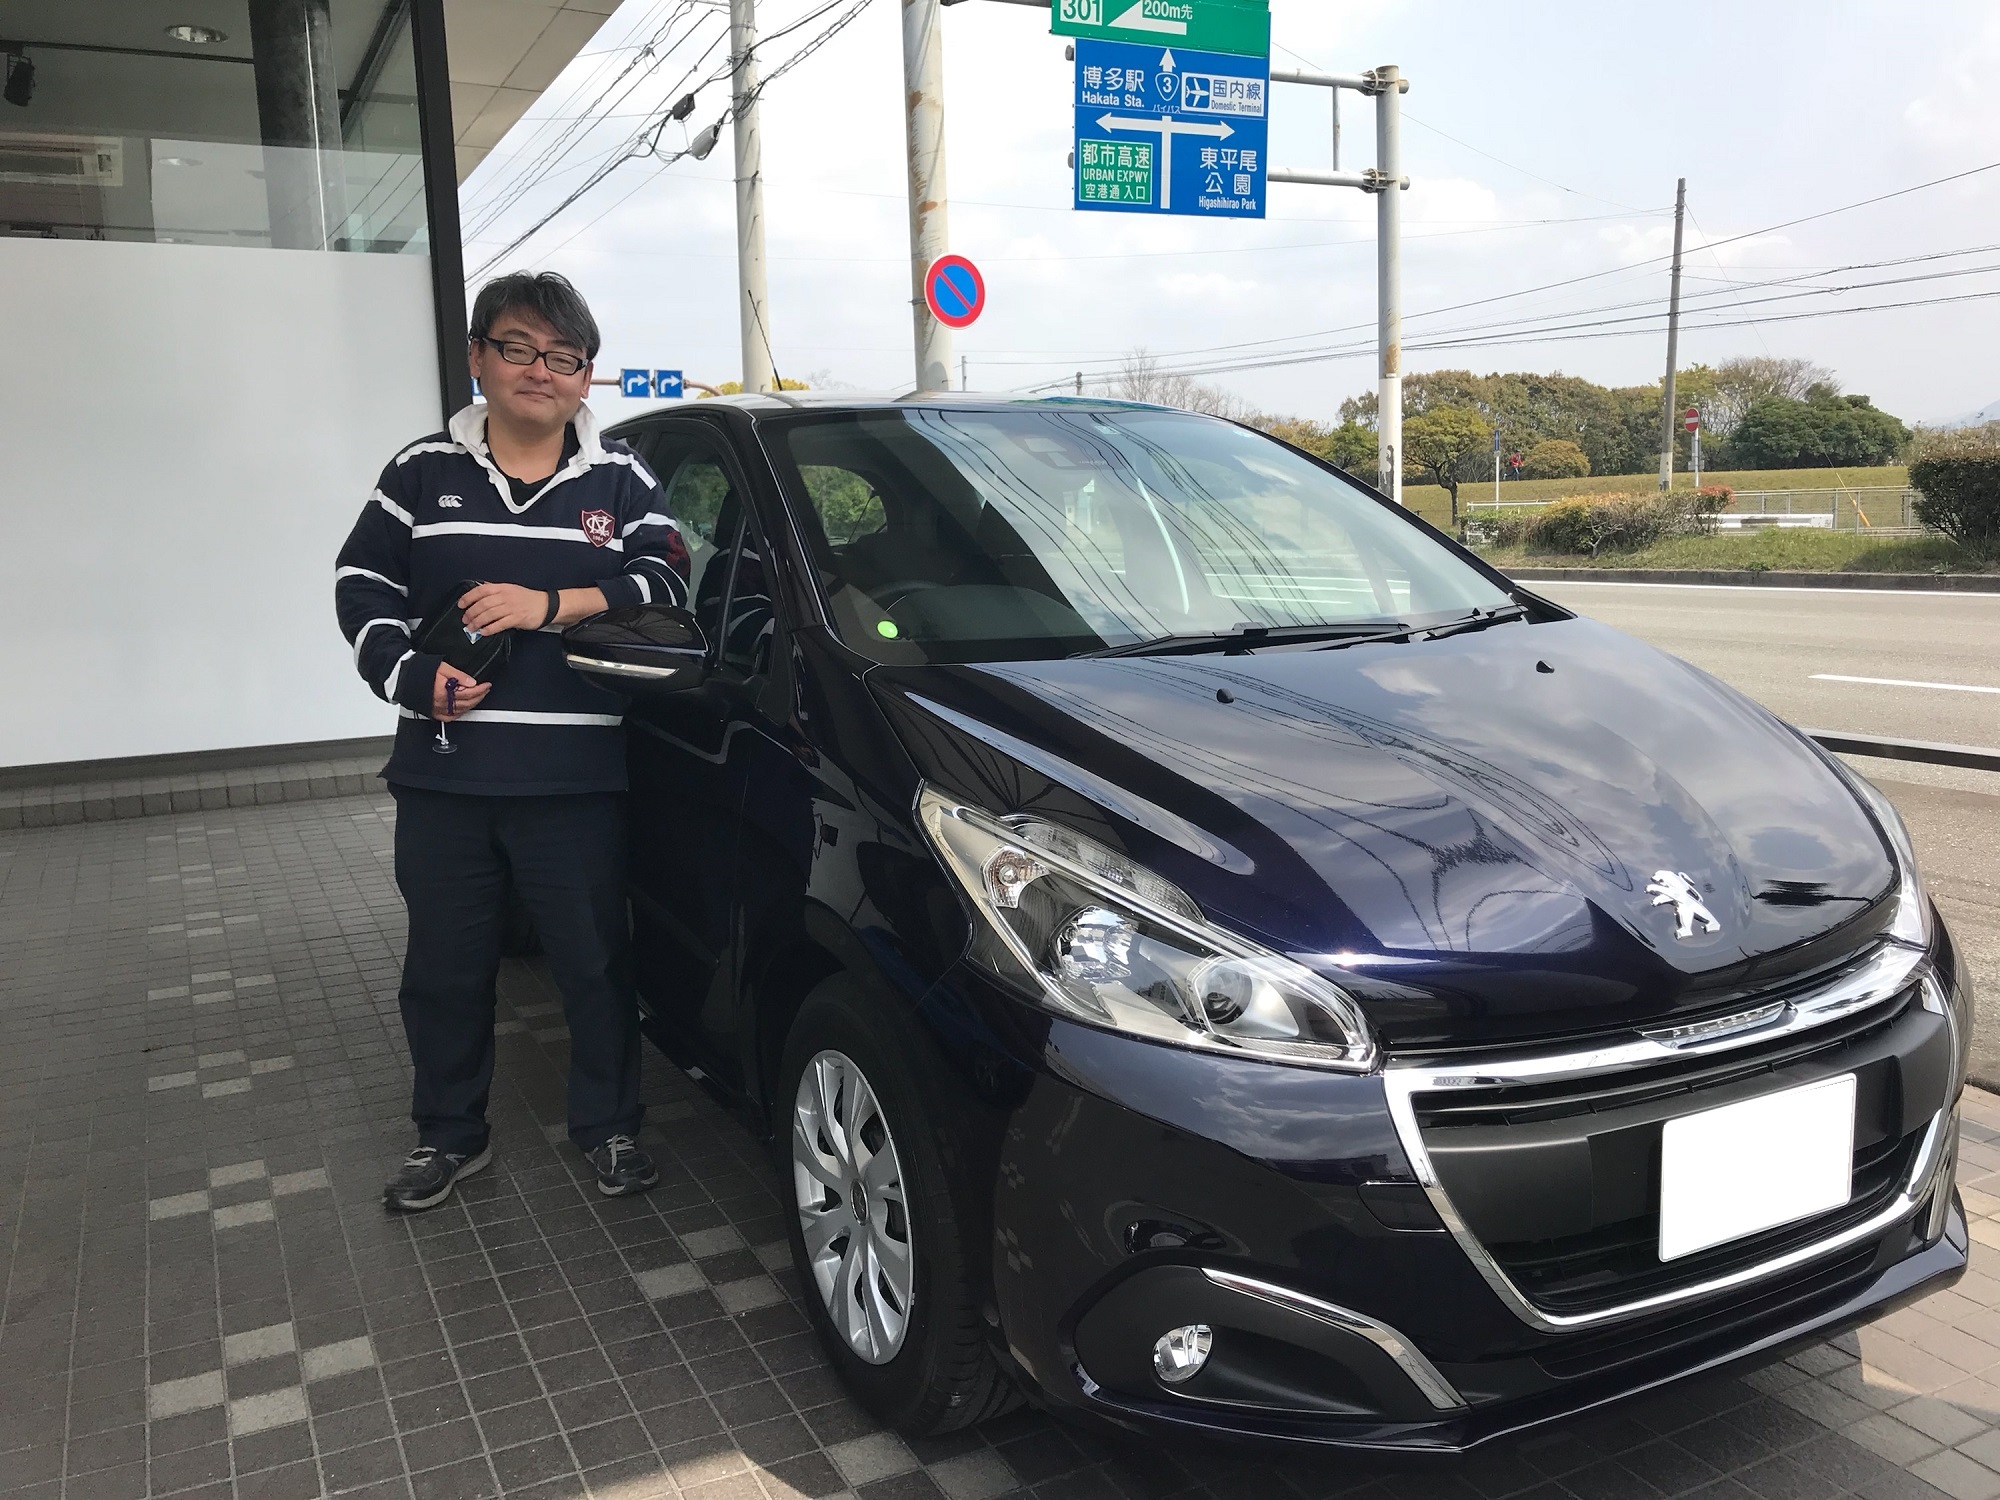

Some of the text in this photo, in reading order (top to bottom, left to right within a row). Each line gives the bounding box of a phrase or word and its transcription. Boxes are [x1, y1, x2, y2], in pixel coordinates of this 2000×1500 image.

[1063, 0, 1100, 22] 301
[1144, 0, 1192, 19] 200m先
[1083, 65, 1145, 92] 博多駅
[1162, 76, 1172, 93] 3
[1082, 91, 1145, 107] Hakata Sta.
[1213, 79, 1262, 100] 国内線
[1152, 104, 1181, 113] バイパス
[1211, 100, 1262, 113] Domestic Terminal
[1083, 142, 1150, 169] 都市高速
[1200, 147, 1257, 172] 東平尾
[1083, 168, 1148, 183] URBAN EXPWY
[1205, 172, 1251, 195] 公園
[1199, 195, 1257, 210] Higashihirao Park
